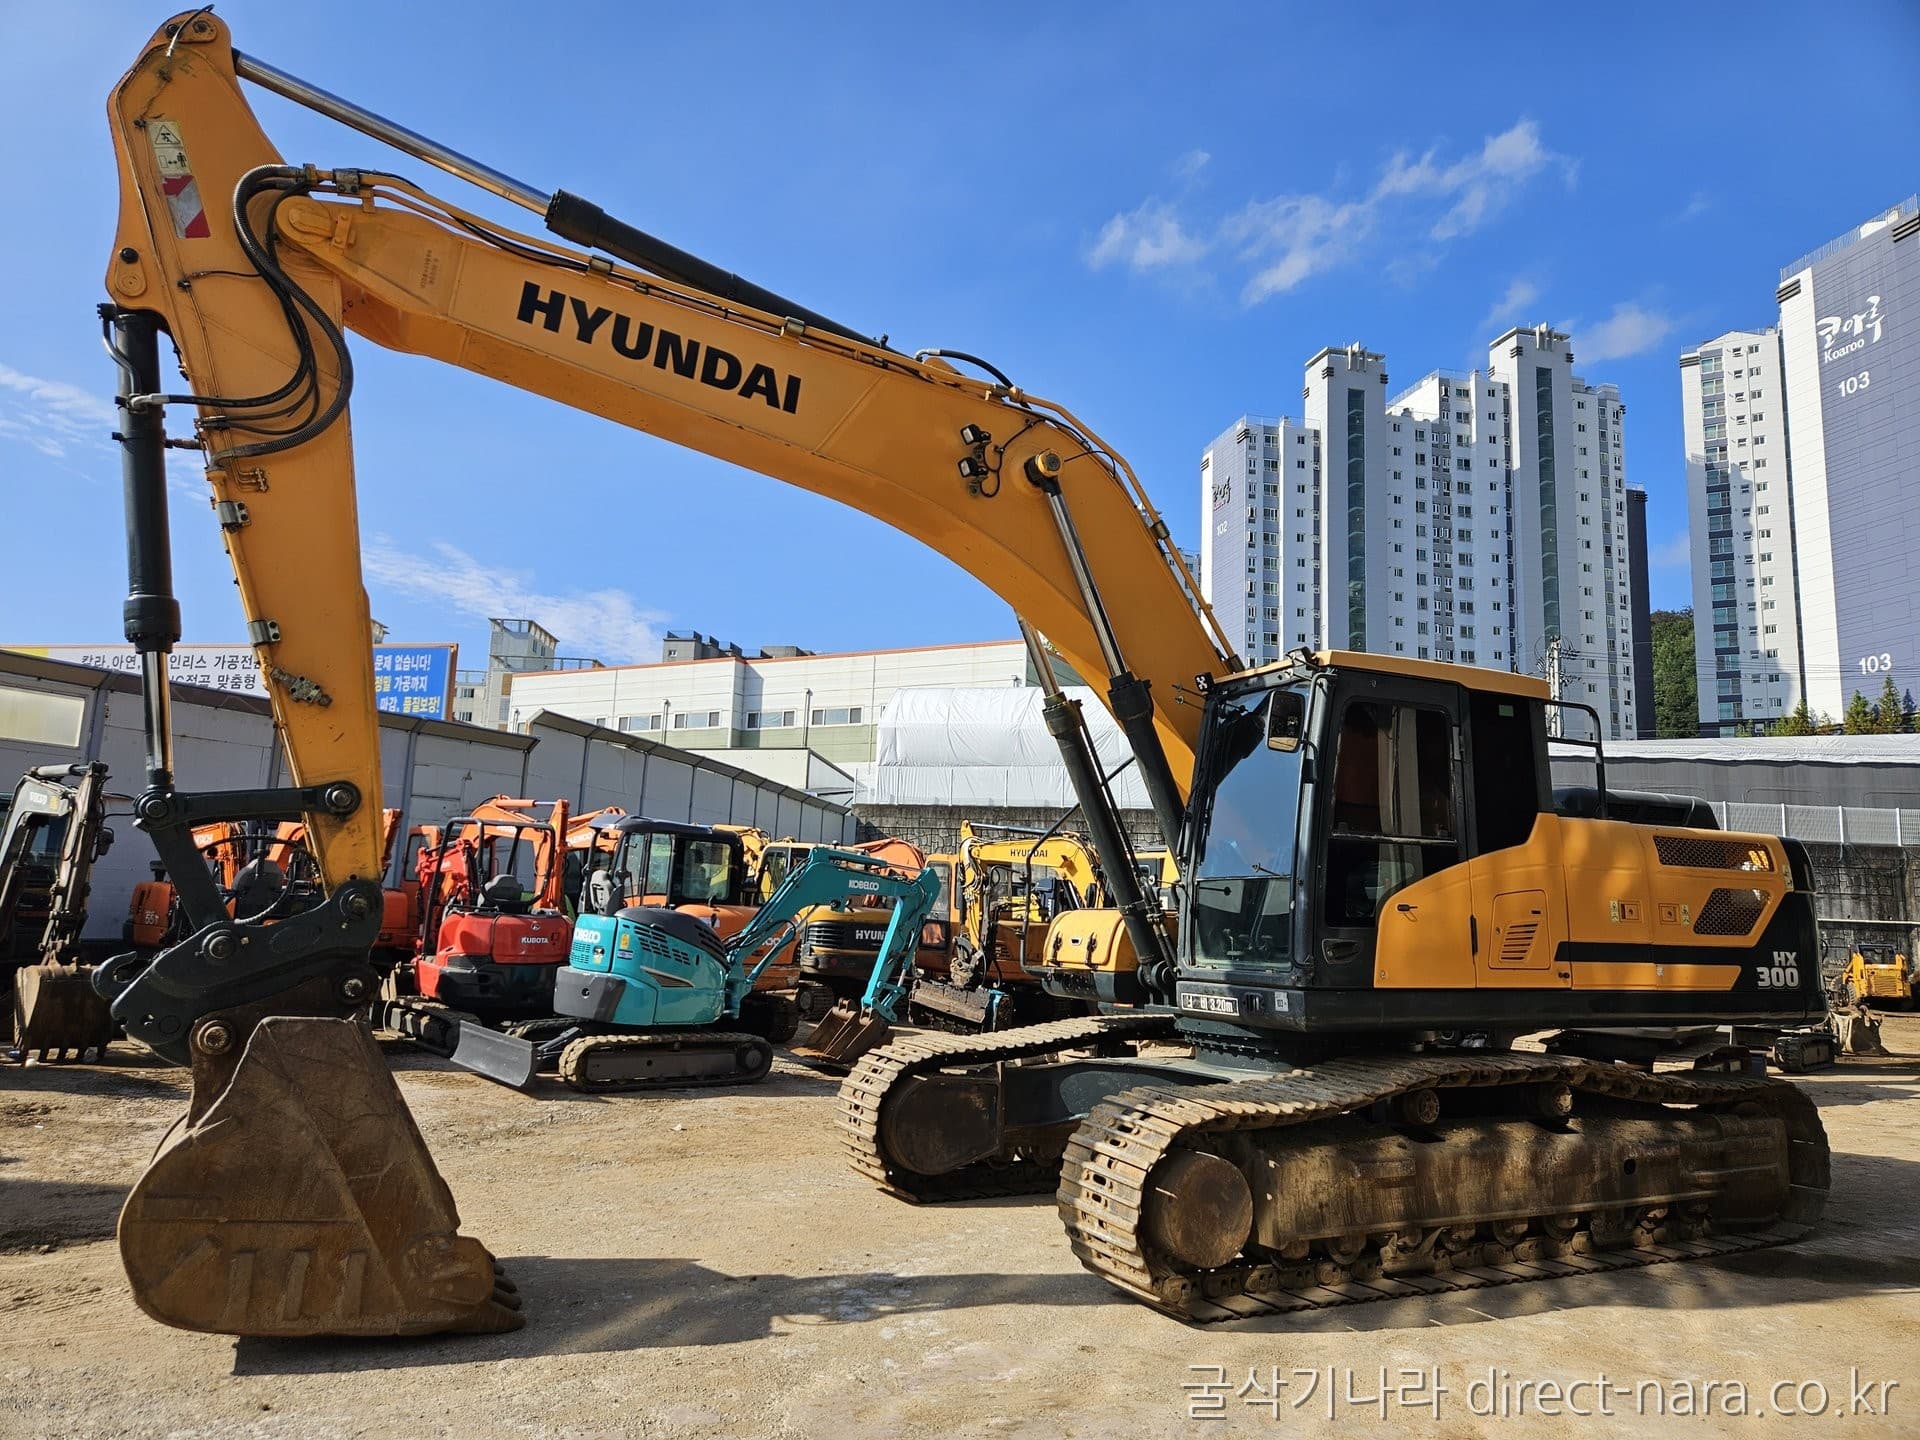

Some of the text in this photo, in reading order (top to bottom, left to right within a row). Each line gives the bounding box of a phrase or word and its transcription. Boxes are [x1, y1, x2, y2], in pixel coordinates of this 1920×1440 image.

[516, 280, 801, 414] HYUNDAI
[1824, 338, 1865, 364] Koaroo
[1838, 371, 1871, 397] 103
[375, 654, 393, 671] 문제
[1859, 653, 1892, 675] 103
[217, 674, 256, 690] 맞춤형
[394, 675, 428, 692] 가공까지
[849, 879, 879, 892] KOBELCO
[521, 936, 549, 944] KUBOTA
[1773, 951, 1797, 967] HX
[1756, 966, 1799, 988] 300
